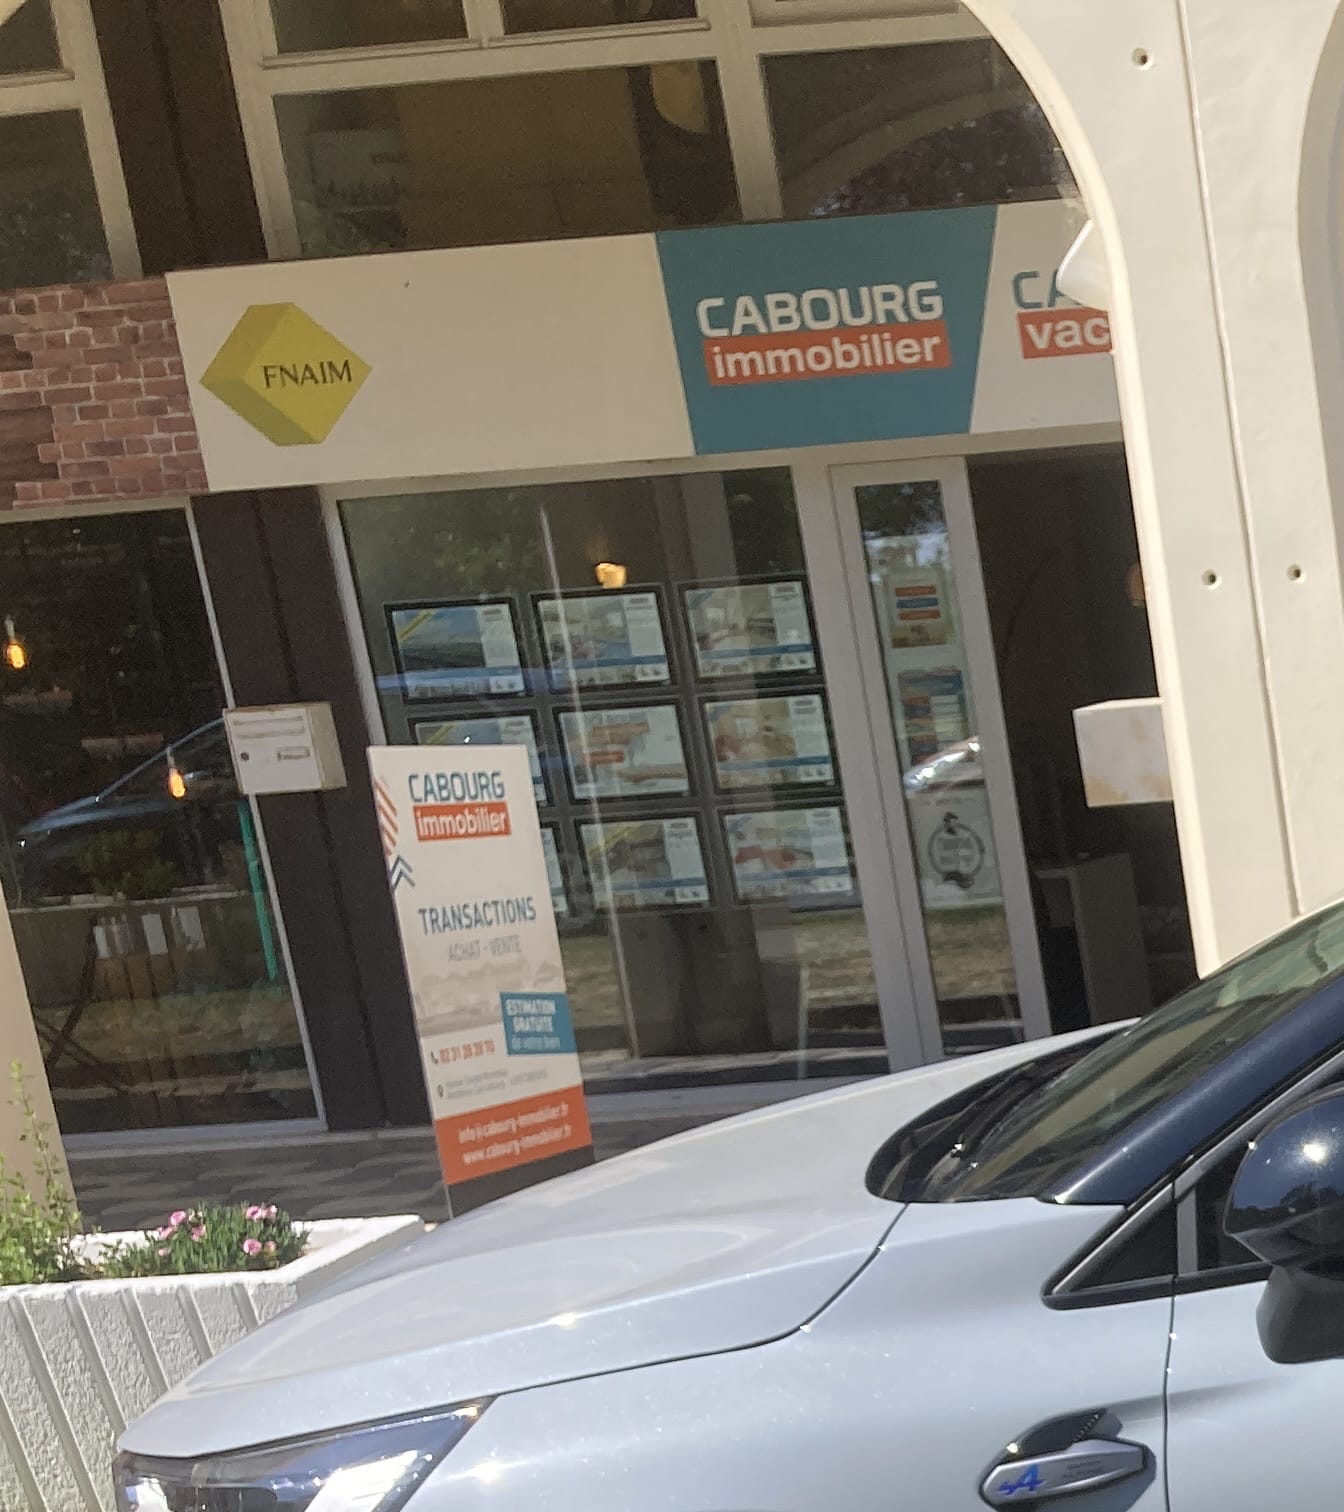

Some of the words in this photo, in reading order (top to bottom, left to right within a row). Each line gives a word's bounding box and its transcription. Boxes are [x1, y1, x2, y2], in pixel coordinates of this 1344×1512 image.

[695, 280, 944, 338] CABOURG
[262, 358, 354, 390] FNAIM
[711, 332, 941, 380] immobilier
[408, 769, 506, 803] CABOURG
[416, 808, 508, 838] immobilier
[417, 896, 537, 936] TRANSACTIONS
